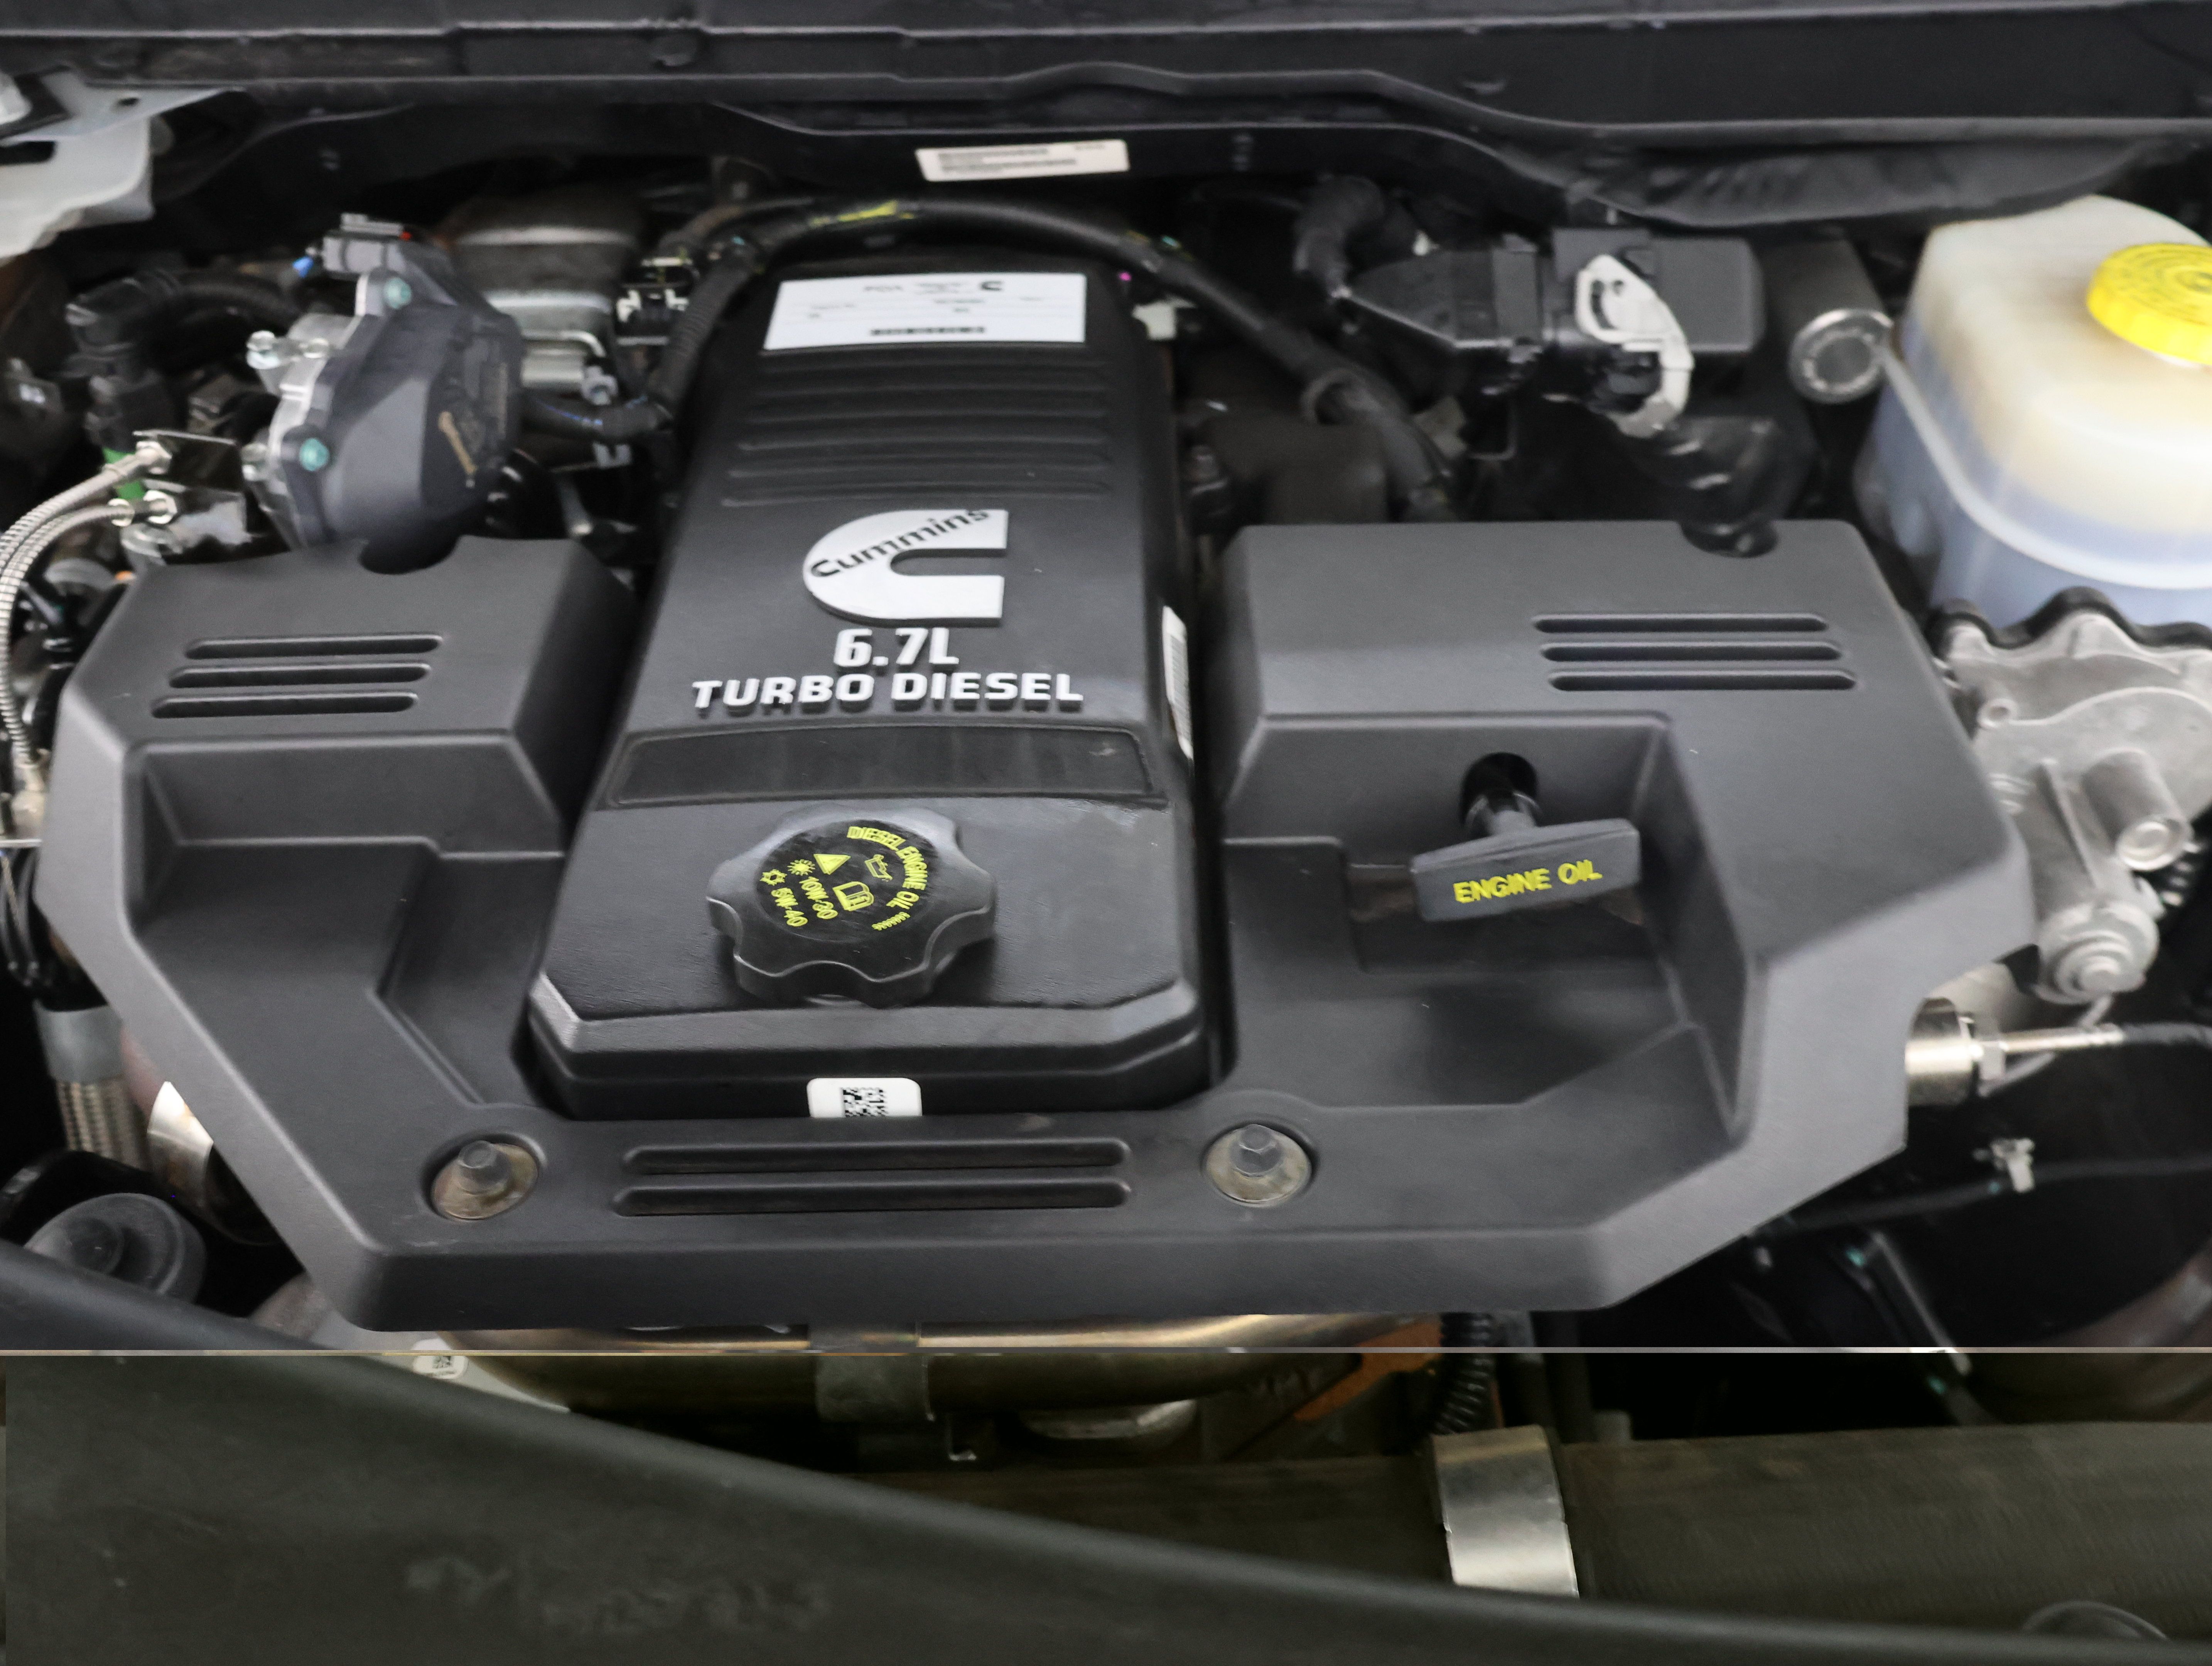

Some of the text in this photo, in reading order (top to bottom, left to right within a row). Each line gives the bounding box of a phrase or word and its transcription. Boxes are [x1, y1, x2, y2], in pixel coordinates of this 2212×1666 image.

[811, 509, 990, 577] Cummins
[834, 627, 959, 667] 6.7L
[692, 672, 1084, 708] TURBO DIESEL
[847, 826, 906, 851] DIESEL
[895, 846, 928, 890] ENGINE
[1453, 859, 1603, 903] ENGINE OIL
[771, 888, 808, 927] 5W-40
[799, 876, 838, 919] 10W-30
[886, 891, 920, 910] OIL
